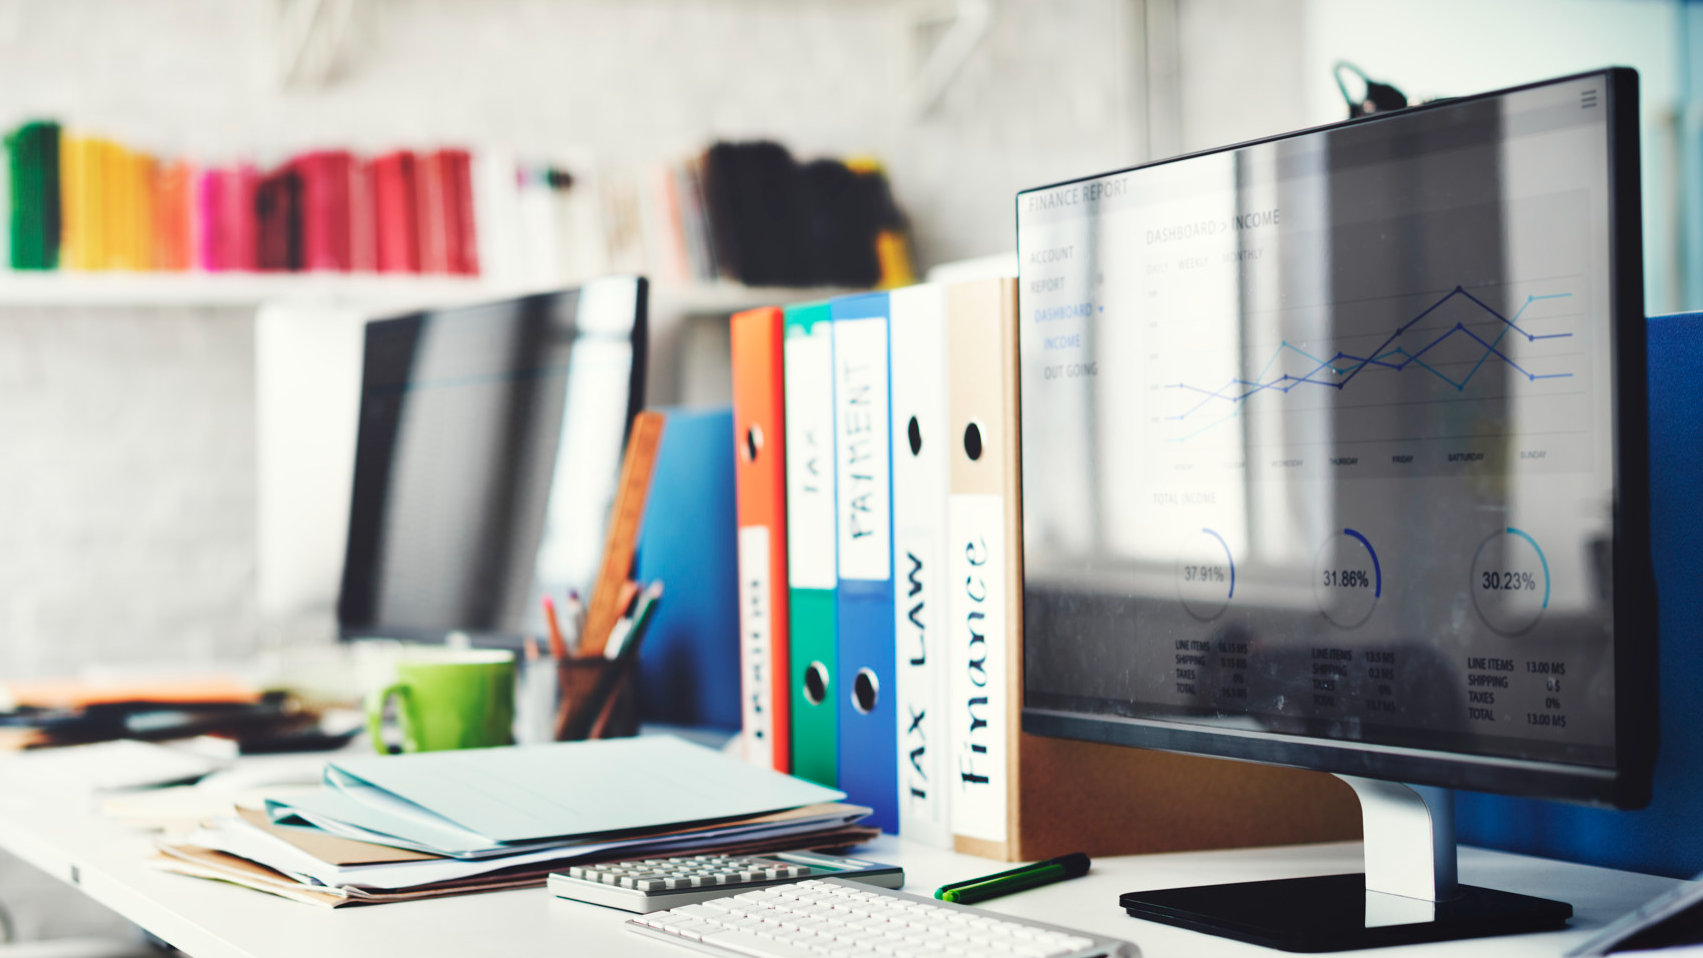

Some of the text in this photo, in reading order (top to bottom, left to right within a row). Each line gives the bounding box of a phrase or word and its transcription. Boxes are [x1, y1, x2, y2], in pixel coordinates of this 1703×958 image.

[1028, 179, 1128, 212] FINANCE REPORT
[1146, 220, 1215, 245] DASHBOARD
[1232, 209, 1280, 230] INCOME
[1030, 246, 1073, 264] ACCOUNT
[1222, 249, 1264, 264] MONTHLY
[1030, 277, 1065, 294] REPORT
[1034, 303, 1092, 324] DASHBOARD
[1044, 334, 1080, 350] INCOME
[1044, 361, 1098, 380] OUT GOING
[844, 360, 874, 539] PAYMENT
[1153, 491, 1216, 505] TOTAL INCOME
[1185, 565, 1224, 582] 37.91%
[1324, 570, 1368, 587] 31.86%
[1482, 572, 1536, 590] 30.23%
[958, 536, 990, 792] Finance
[1468, 657, 1486, 670] LINE
[1488, 658, 1514, 672] ITEMS
[1526, 661, 1550, 674] 13.00
[907, 551, 928, 803] TAX LAW
[1468, 674, 1508, 688] SHIPPING
[1468, 690, 1560, 709] TAXES 0%
[1468, 707, 1495, 721] TOTAL
[1526, 713, 1550, 726] 13.00
